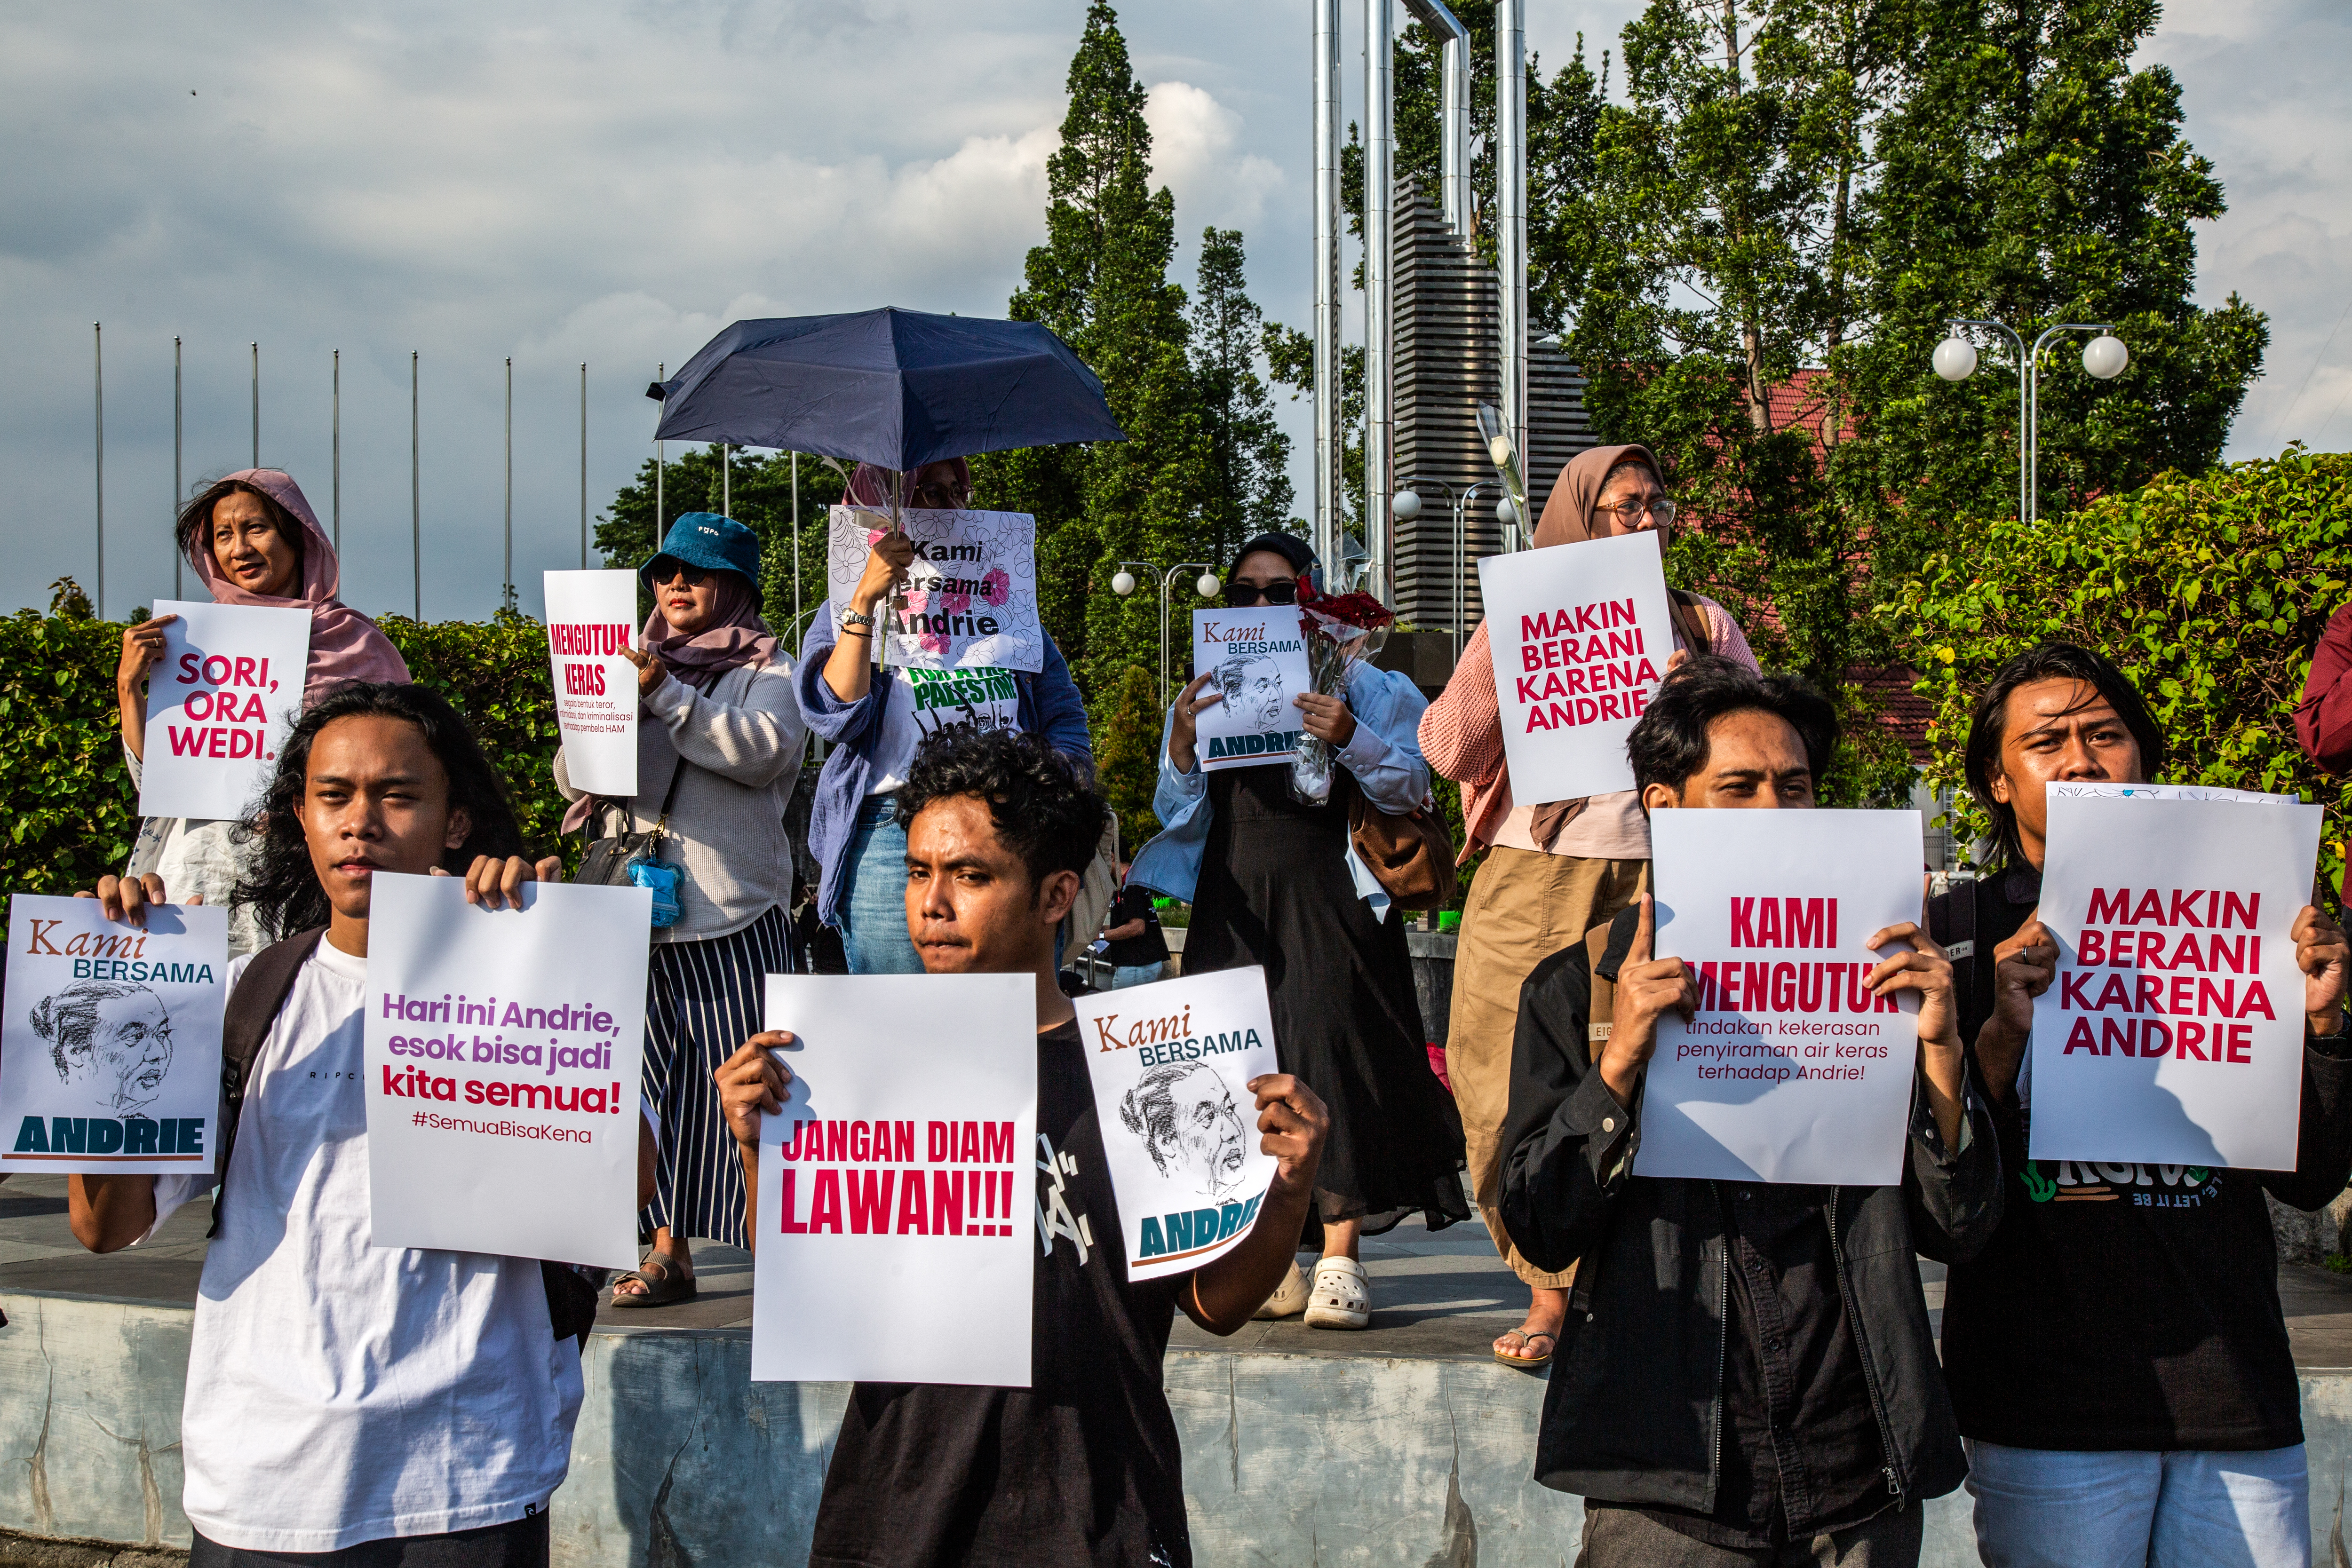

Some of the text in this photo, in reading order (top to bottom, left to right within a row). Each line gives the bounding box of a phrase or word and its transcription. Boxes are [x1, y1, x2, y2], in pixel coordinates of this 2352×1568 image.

[910, 540, 983, 562] Kami
[900, 576, 992, 596] ersama
[1203, 622, 1265, 643] Kami
[1521, 598, 1637, 642] MAKIN
[550, 624, 631, 656] MENGUTUK
[1228, 640, 1302, 654] BERSAMA
[1521, 628, 1645, 673] BERANI
[176, 653, 278, 694] SORI,
[564, 663, 605, 696] KERAS
[914, 673, 1017, 711] PALESTINE
[1516, 657, 1661, 704] KARENA
[184, 690, 268, 723] ORA
[559, 709, 633, 721] intimidasi, dan kriminalisasi
[564, 699, 615, 710] segala bentuk teror,
[1526, 689, 1648, 734] ANDRIE
[167, 726, 275, 760] WEDI.
[564, 721, 625, 734] terhadap pembela HAM
[1731, 897, 1837, 949] KAMI
[2086, 887, 2261, 930] MAKIN
[26, 919, 149, 959] Kami
[2077, 930, 2261, 975] BERANI
[73, 959, 215, 984] BERSAMA
[383, 993, 620, 1037] Hari ini Andrie,
[2060, 971, 2276, 1021] KARENA
[1093, 1004, 1192, 1053] Kami
[1685, 1019, 1880, 1035] tindakan kekerasan
[2063, 1016, 2253, 1064] ANDRIE
[389, 1034, 612, 1076] esok bisa jadi
[1138, 1028, 1263, 1067] BERSAMA
[1677, 1041, 1888, 1061] penyiraman air keras
[382, 1064, 620, 1115] kita semua!
[1698, 1064, 1865, 1084] terhadap Andrie!
[13, 1116, 205, 1154] ANDRIE
[412, 1111, 592, 1143] #SemuaBisaKena
[782, 1120, 1015, 1164] JANGAN DIAM
[781, 1169, 1014, 1237] LAWAN!!!
[2133, 1193, 2152, 1206] BE
[2156, 1194, 2169, 1207] IT
[2173, 1195, 2201, 1207] LET
[1139, 1187, 1267, 1258] ANDRIE
